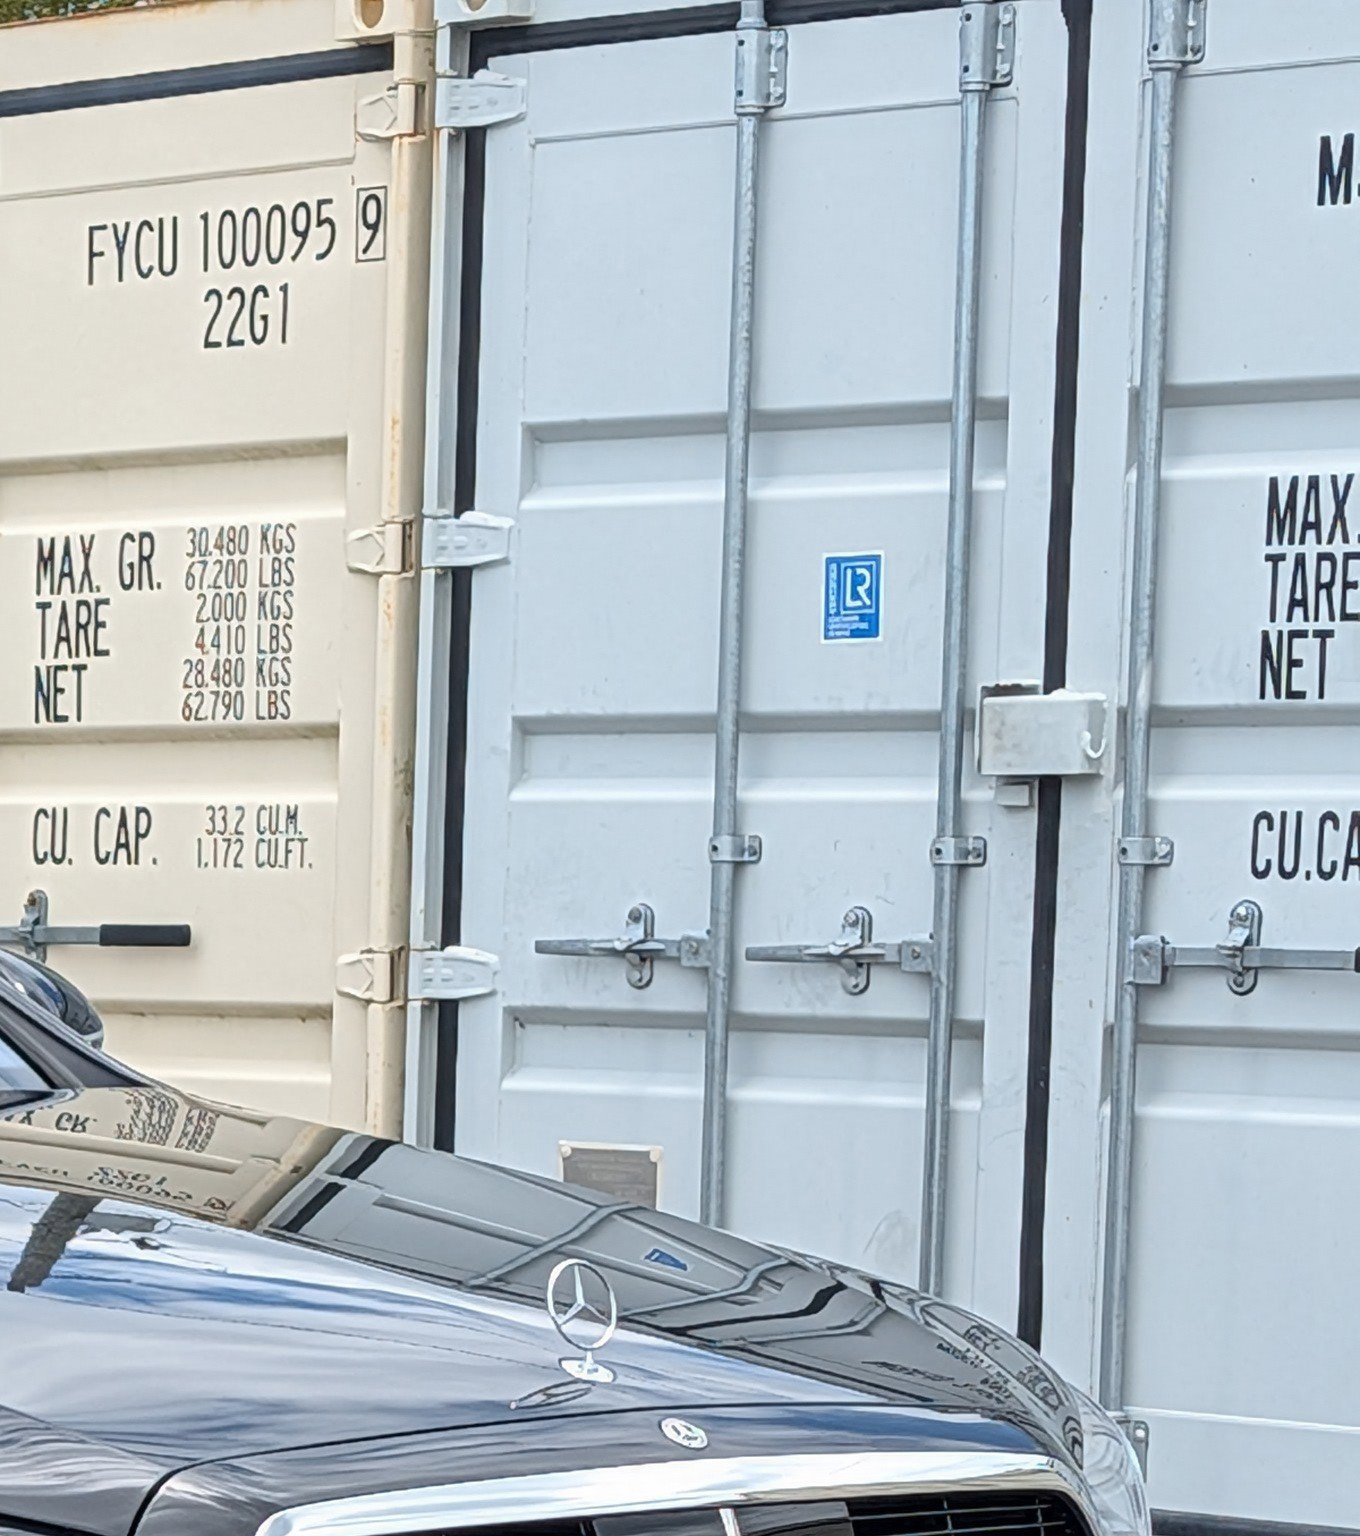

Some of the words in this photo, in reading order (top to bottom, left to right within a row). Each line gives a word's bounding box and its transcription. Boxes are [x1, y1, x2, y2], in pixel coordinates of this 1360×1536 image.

[1317, 132, 1360, 206] M
[88, 216, 178, 285] FYCU
[199, 198, 336, 273] 100095
[359, 191, 384, 257] 9
[203, 282, 289, 349] 22G1
[36, 533, 101, 596] MAX.
[118, 531, 162, 591] GR.
[185, 525, 249, 558] 30.480
[260, 523, 297, 555] KGS
[258, 557, 295, 587] LBS
[1264, 551, 1360, 622] TARE
[35, 598, 110, 660] TARE
[258, 590, 294, 621] KGS
[195, 624, 246, 655] 4.410
[257, 623, 293, 654] LBS
[1259, 629, 1335, 700] NET
[34, 664, 88, 724] NET
[182, 657, 245, 689] 28.480
[256, 656, 292, 687] KGS
[256, 689, 291, 720] LBS
[32, 806, 73, 865] CU.
[94, 806, 158, 865] CAP.
[205, 804, 245, 836] 33.2
[197, 837, 244, 868] 1.172
